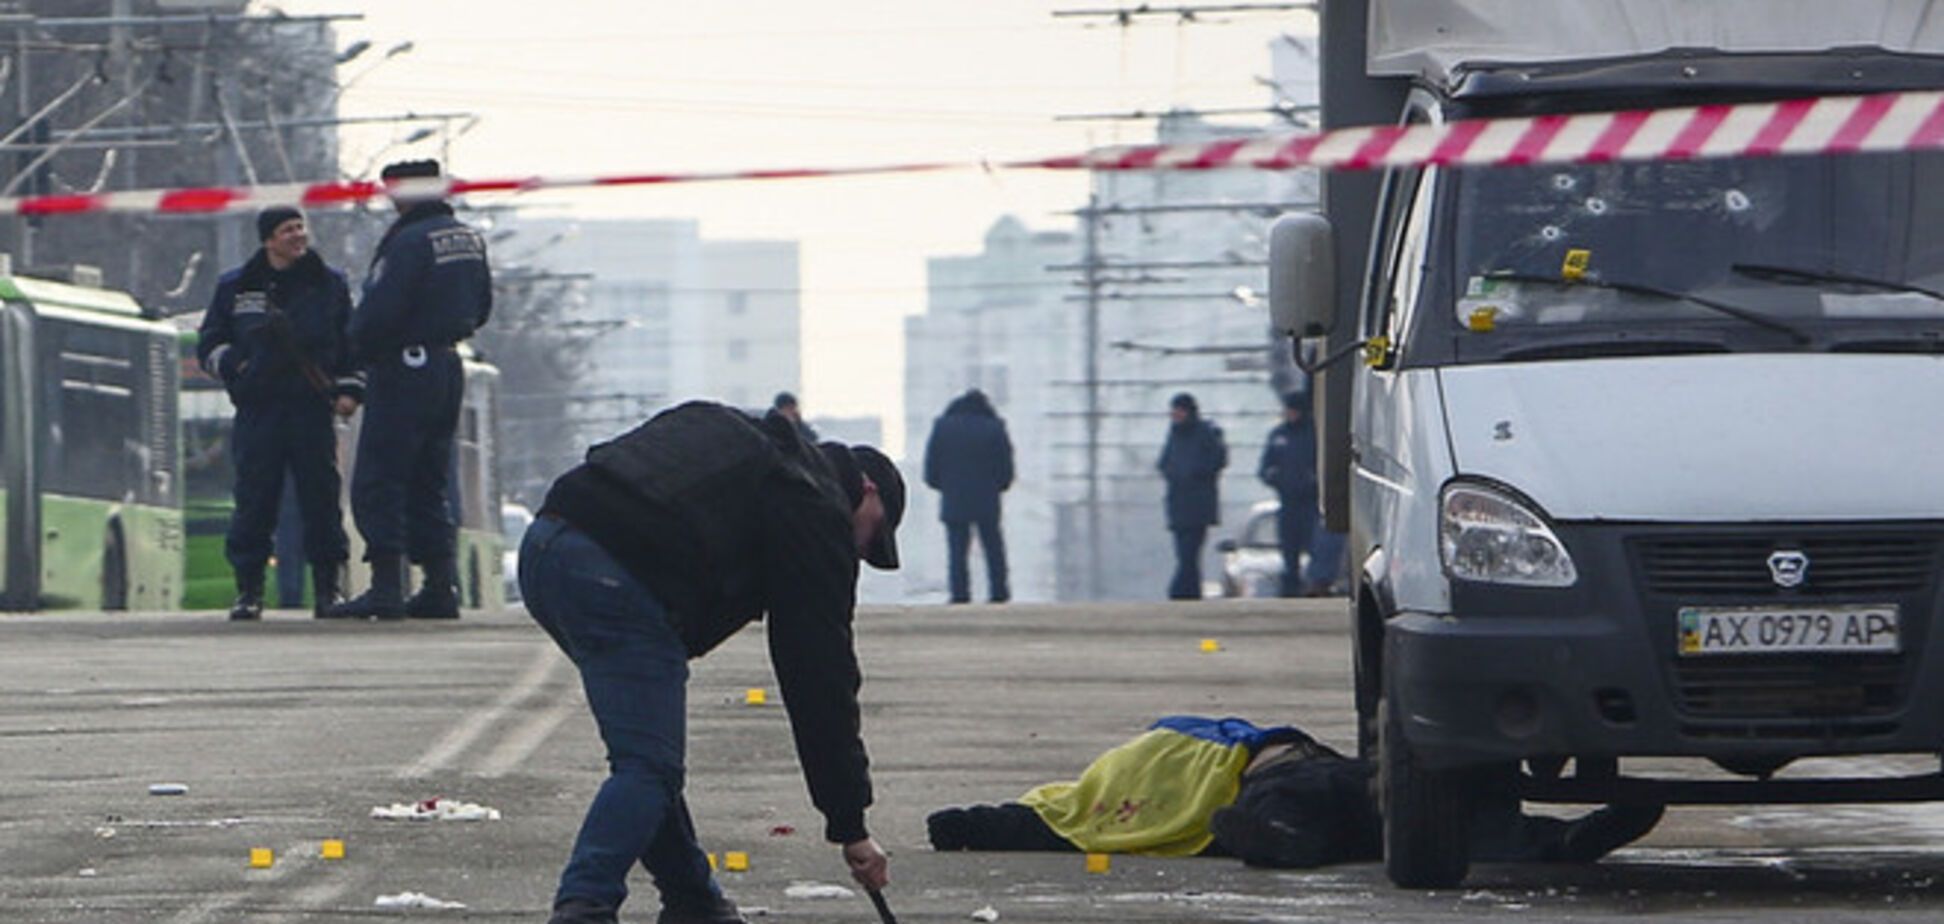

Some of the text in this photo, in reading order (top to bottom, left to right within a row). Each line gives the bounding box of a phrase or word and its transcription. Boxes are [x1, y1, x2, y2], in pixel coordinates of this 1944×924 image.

[1704, 614, 1888, 646] AX 0979 AP
